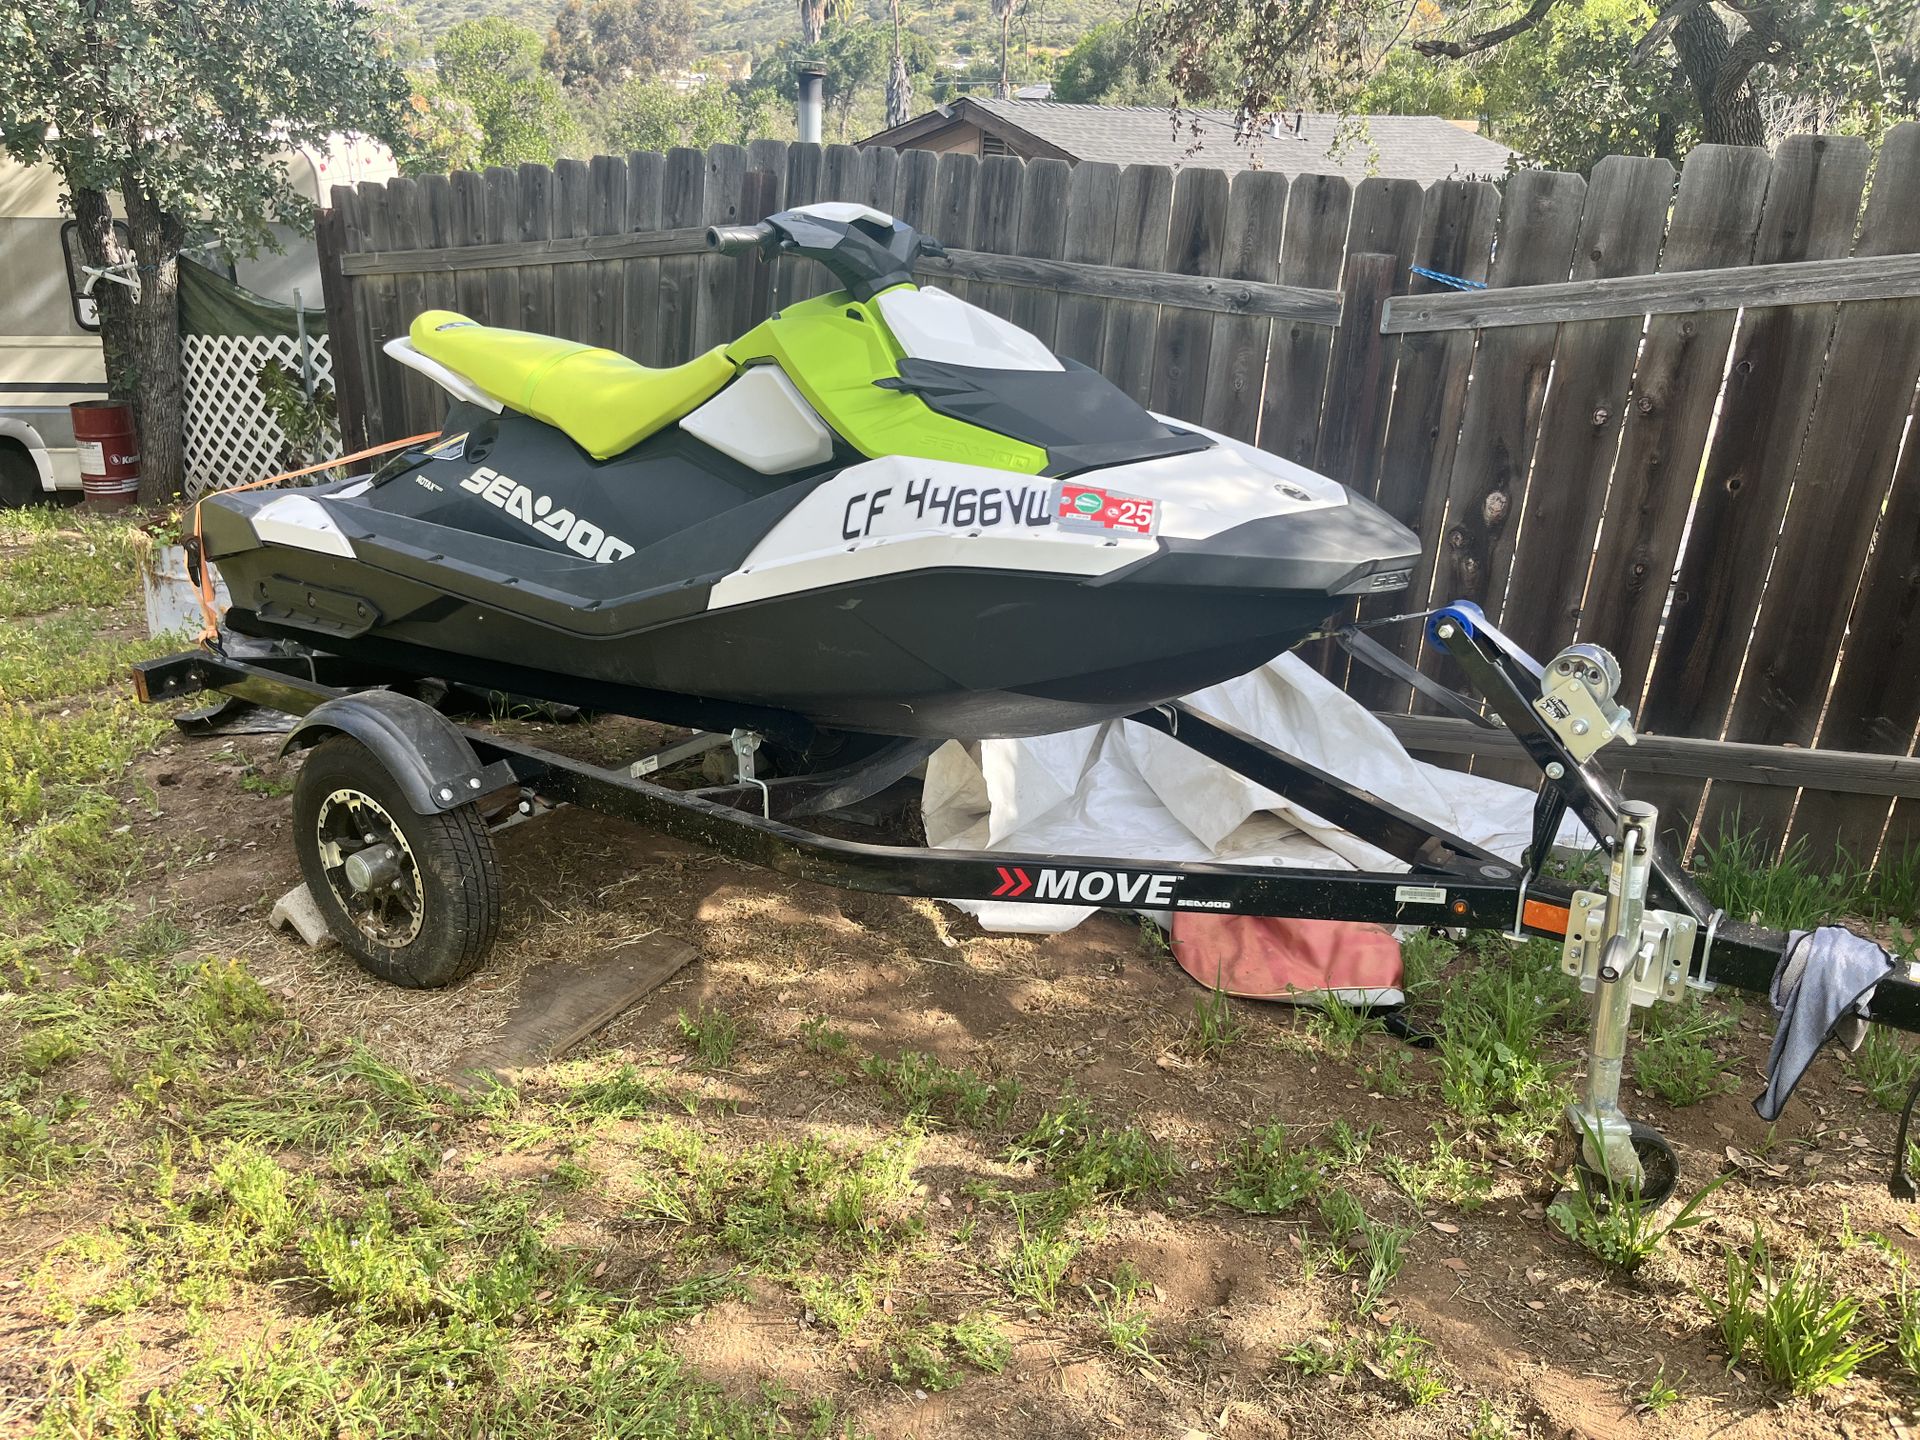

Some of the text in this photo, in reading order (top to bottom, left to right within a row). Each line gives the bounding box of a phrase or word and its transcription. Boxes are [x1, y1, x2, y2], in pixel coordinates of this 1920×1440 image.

[842, 487, 892, 541] CF
[1118, 501, 1152, 526] 25
[1034, 869, 1177, 905] MOVE
